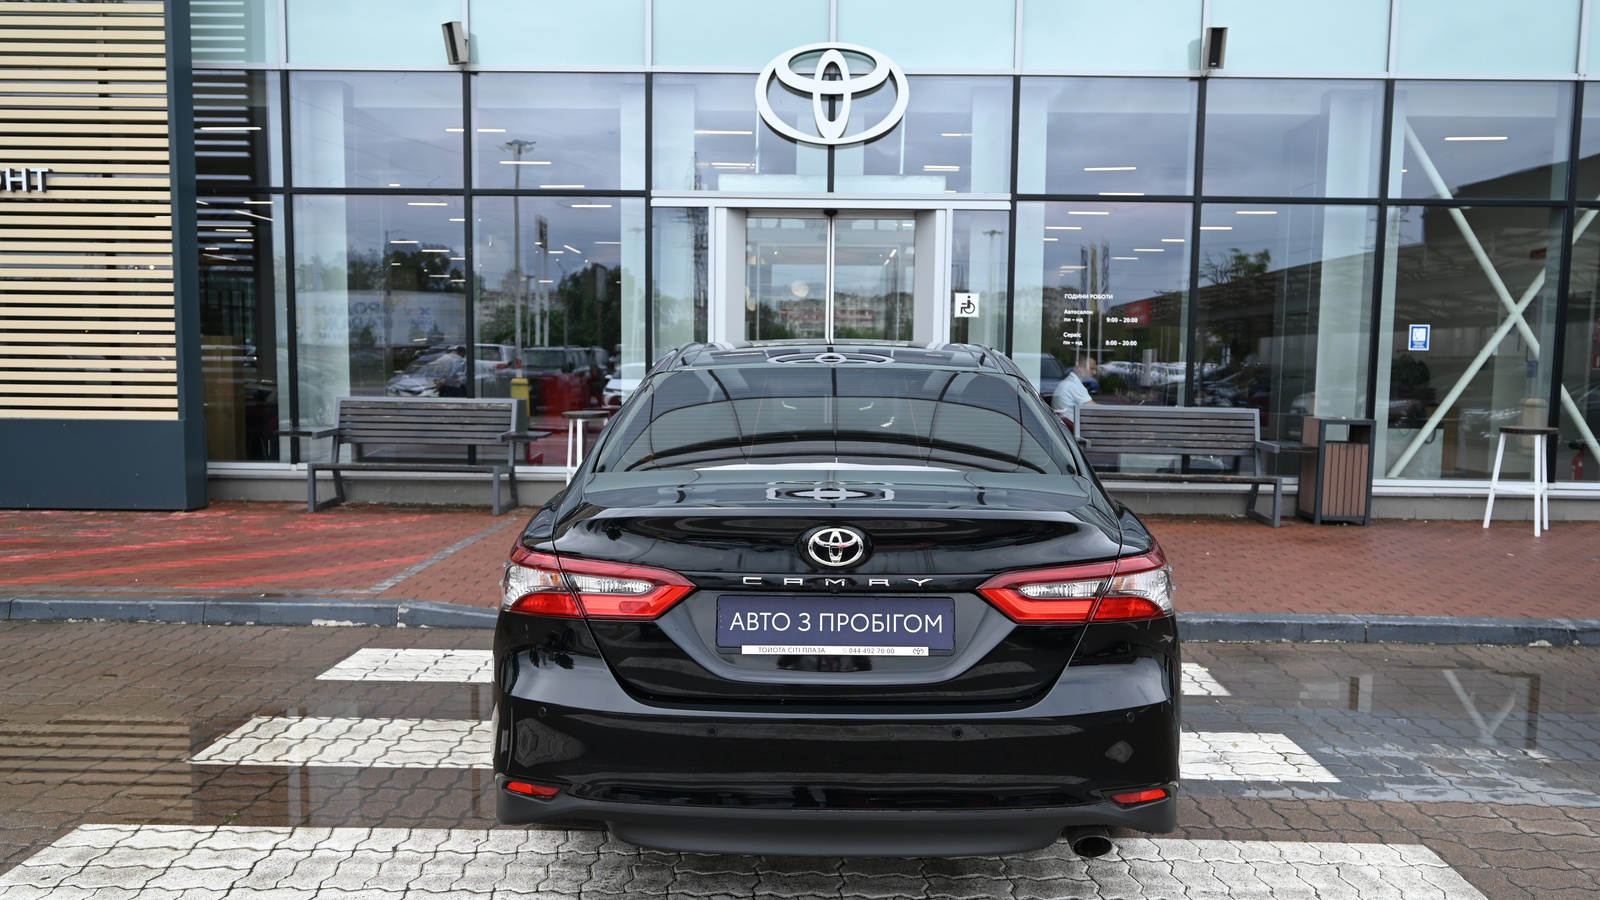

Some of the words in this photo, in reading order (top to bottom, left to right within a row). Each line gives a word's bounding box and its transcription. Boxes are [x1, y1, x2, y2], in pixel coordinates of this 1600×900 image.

[0, 168, 49, 192] НТ
[742, 576, 933, 587] CAMRY
[729, 611, 791, 632] АВТО
[819, 612, 943, 634] ПРОБІГОМ
